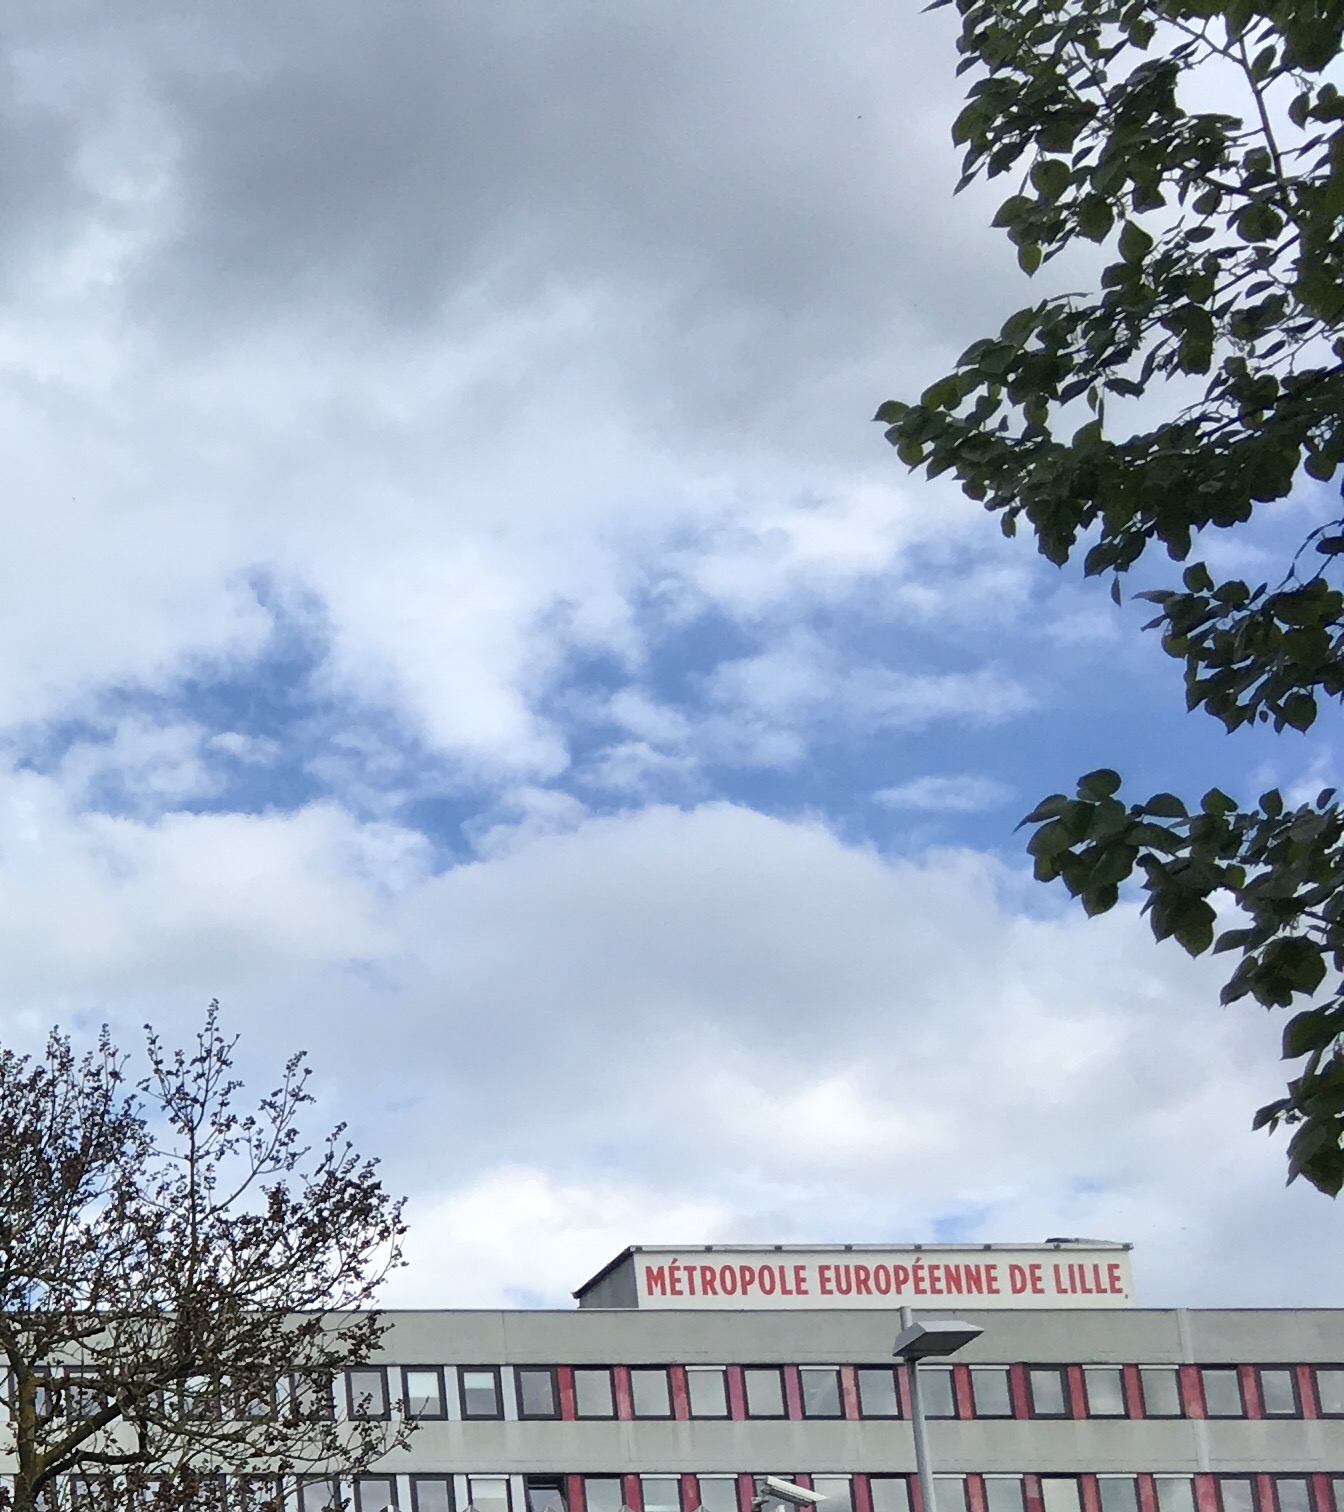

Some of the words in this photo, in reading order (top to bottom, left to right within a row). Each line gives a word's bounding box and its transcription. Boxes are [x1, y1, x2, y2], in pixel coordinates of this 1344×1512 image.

[645, 1258, 809, 1296] MÉTROPOLE
[818, 1257, 1000, 1296] EUROPÉENNE
[1010, 1264, 1045, 1294] DE
[1054, 1263, 1124, 1295] LILLE
